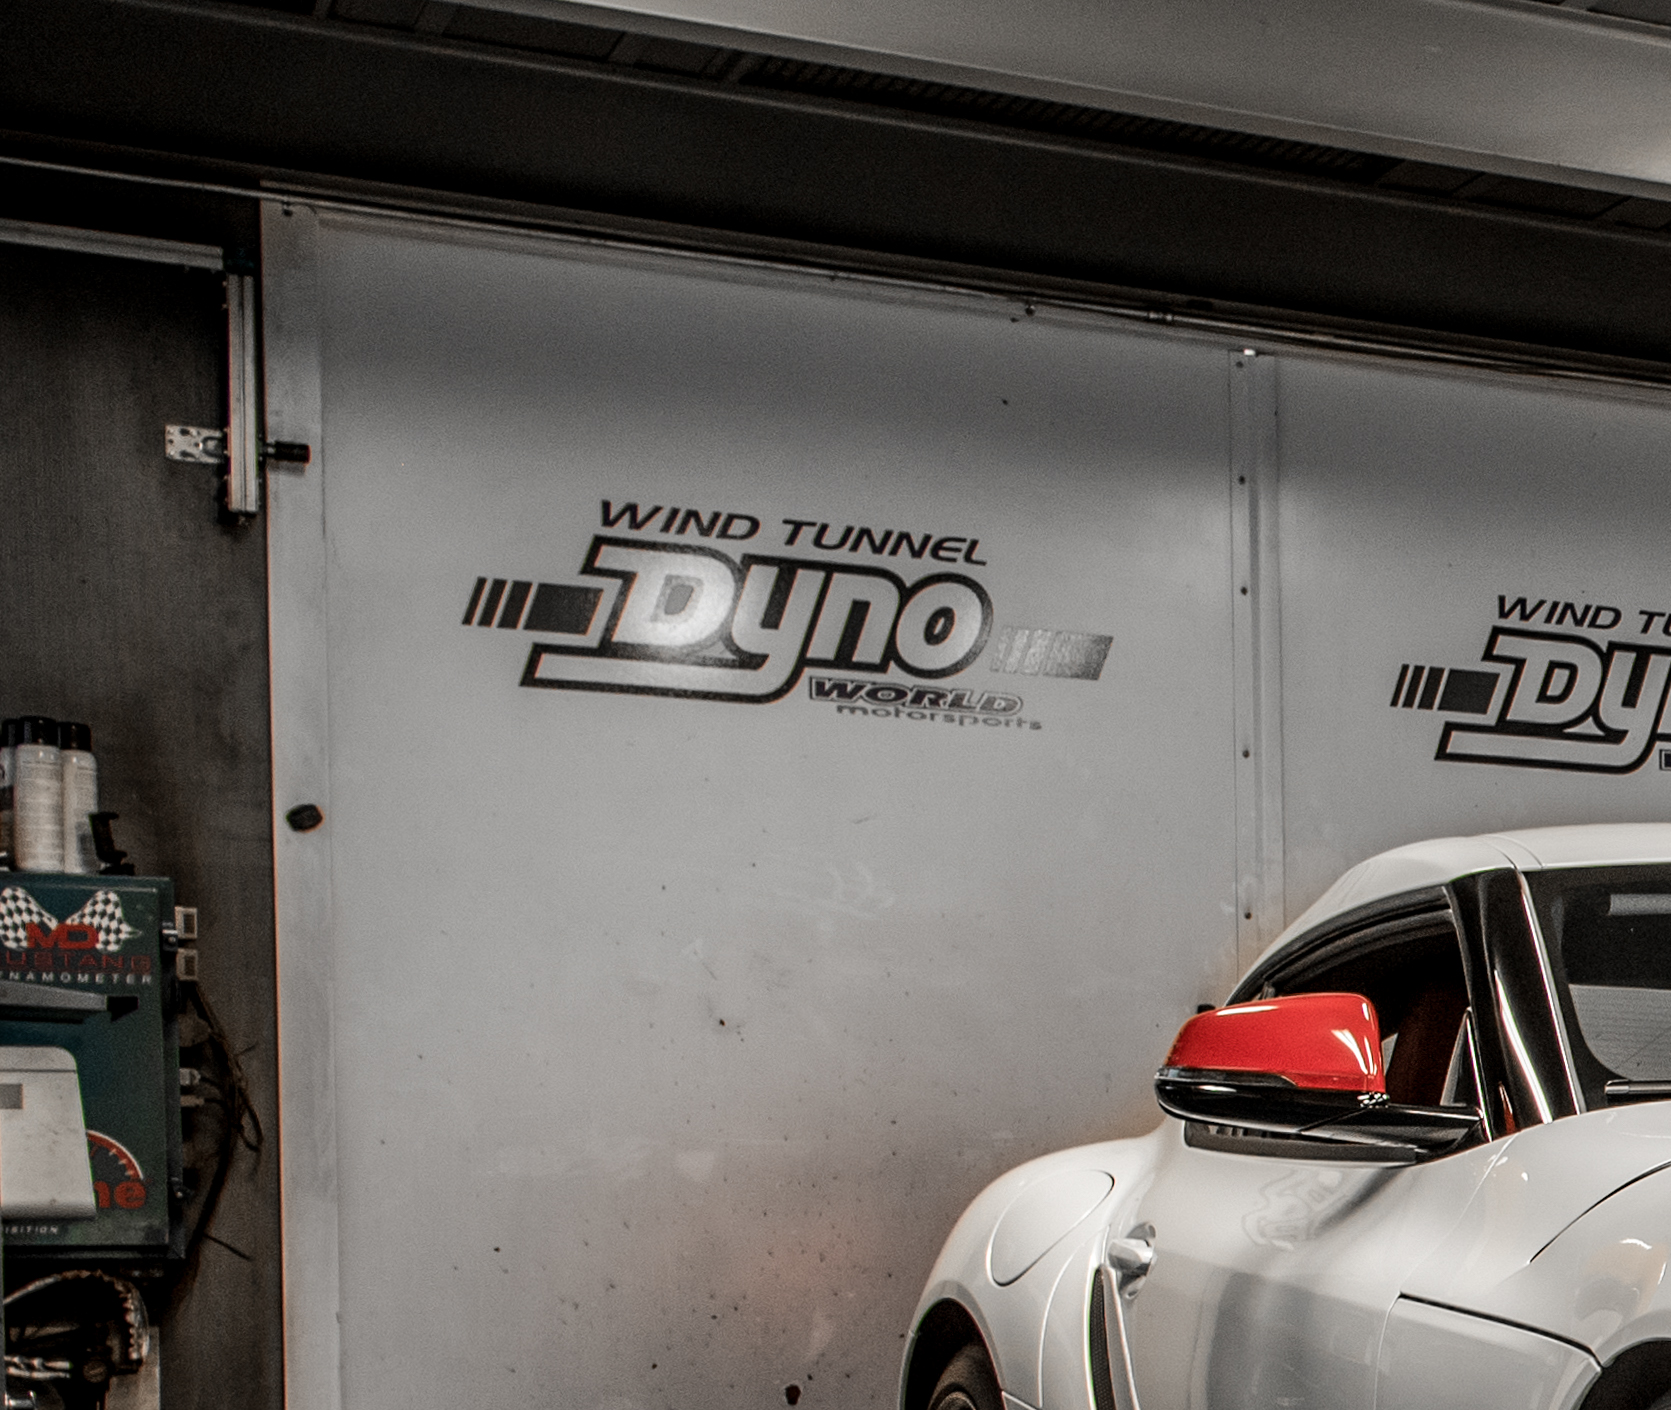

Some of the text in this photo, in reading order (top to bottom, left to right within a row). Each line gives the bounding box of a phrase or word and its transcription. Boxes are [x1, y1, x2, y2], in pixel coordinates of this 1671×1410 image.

[600, 499, 989, 567] WIND TUNNEL
[519, 533, 994, 705] Dyno
[1497, 594, 1623, 631] WIND
[808, 676, 1024, 717] WORLD
[836, 703, 1044, 732] motorsports
[0, 950, 151, 974] USTANG
[0, 971, 152, 985] NAMOMETER
